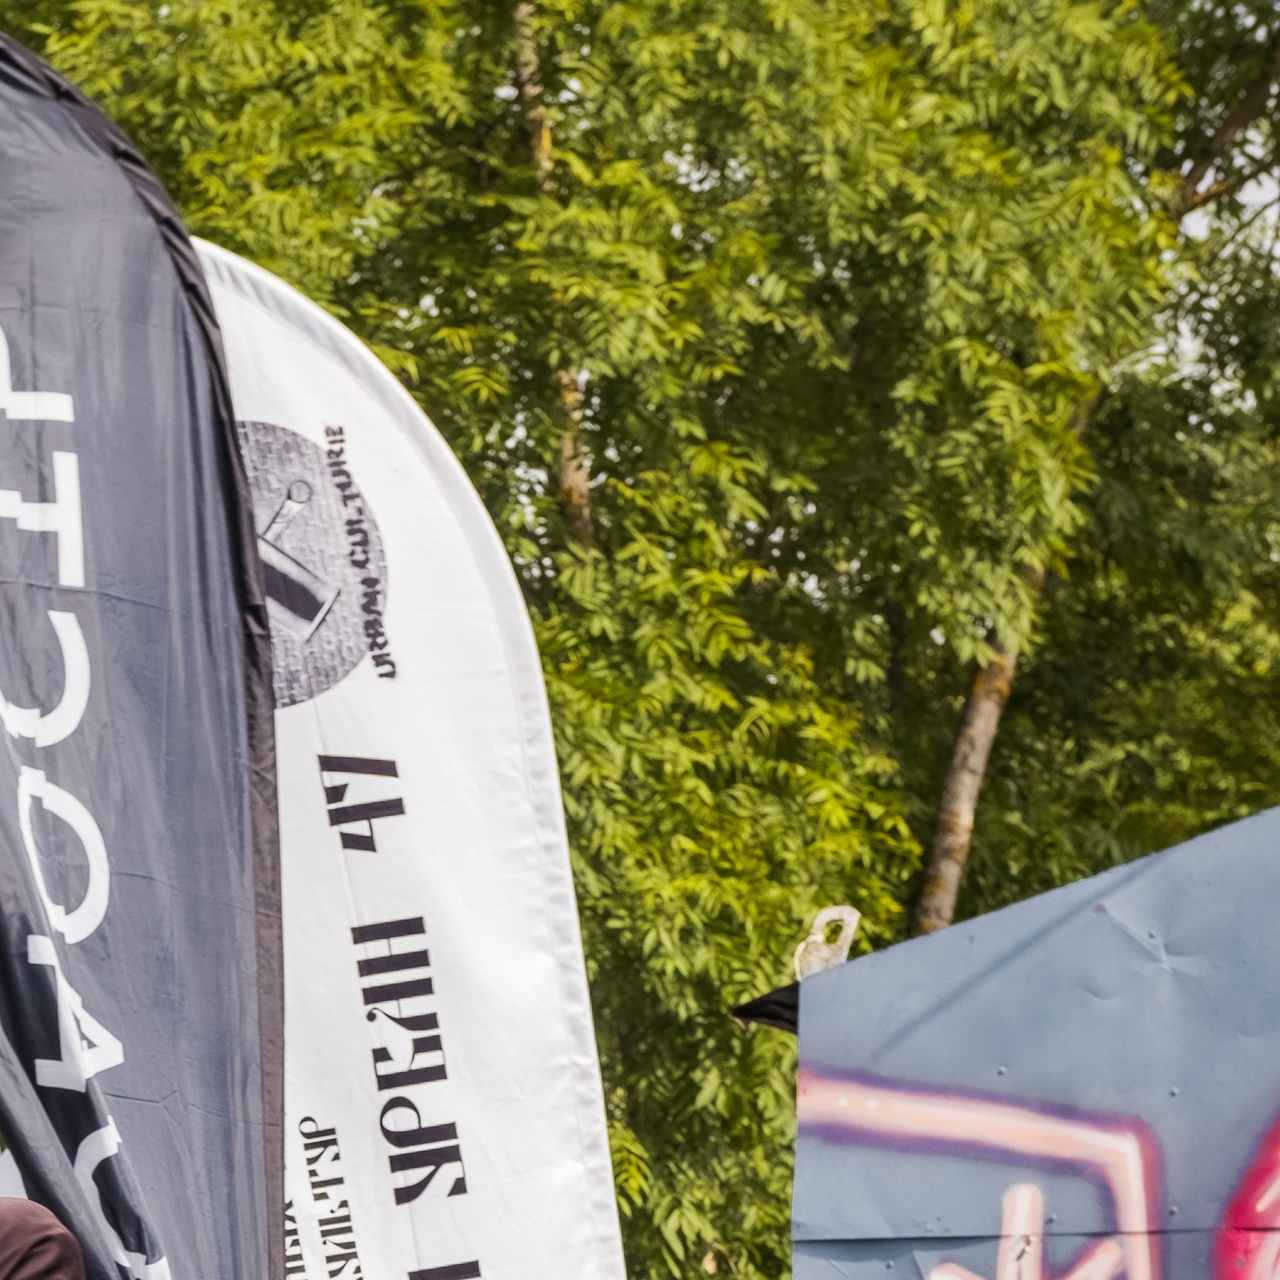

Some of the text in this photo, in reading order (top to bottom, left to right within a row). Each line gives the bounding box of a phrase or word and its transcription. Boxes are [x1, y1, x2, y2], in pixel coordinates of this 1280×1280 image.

[324, 424, 397, 678] URBAN CULTURE
[318, 754, 405, 852] 47
[350, 916, 468, 1206] УРБАН
